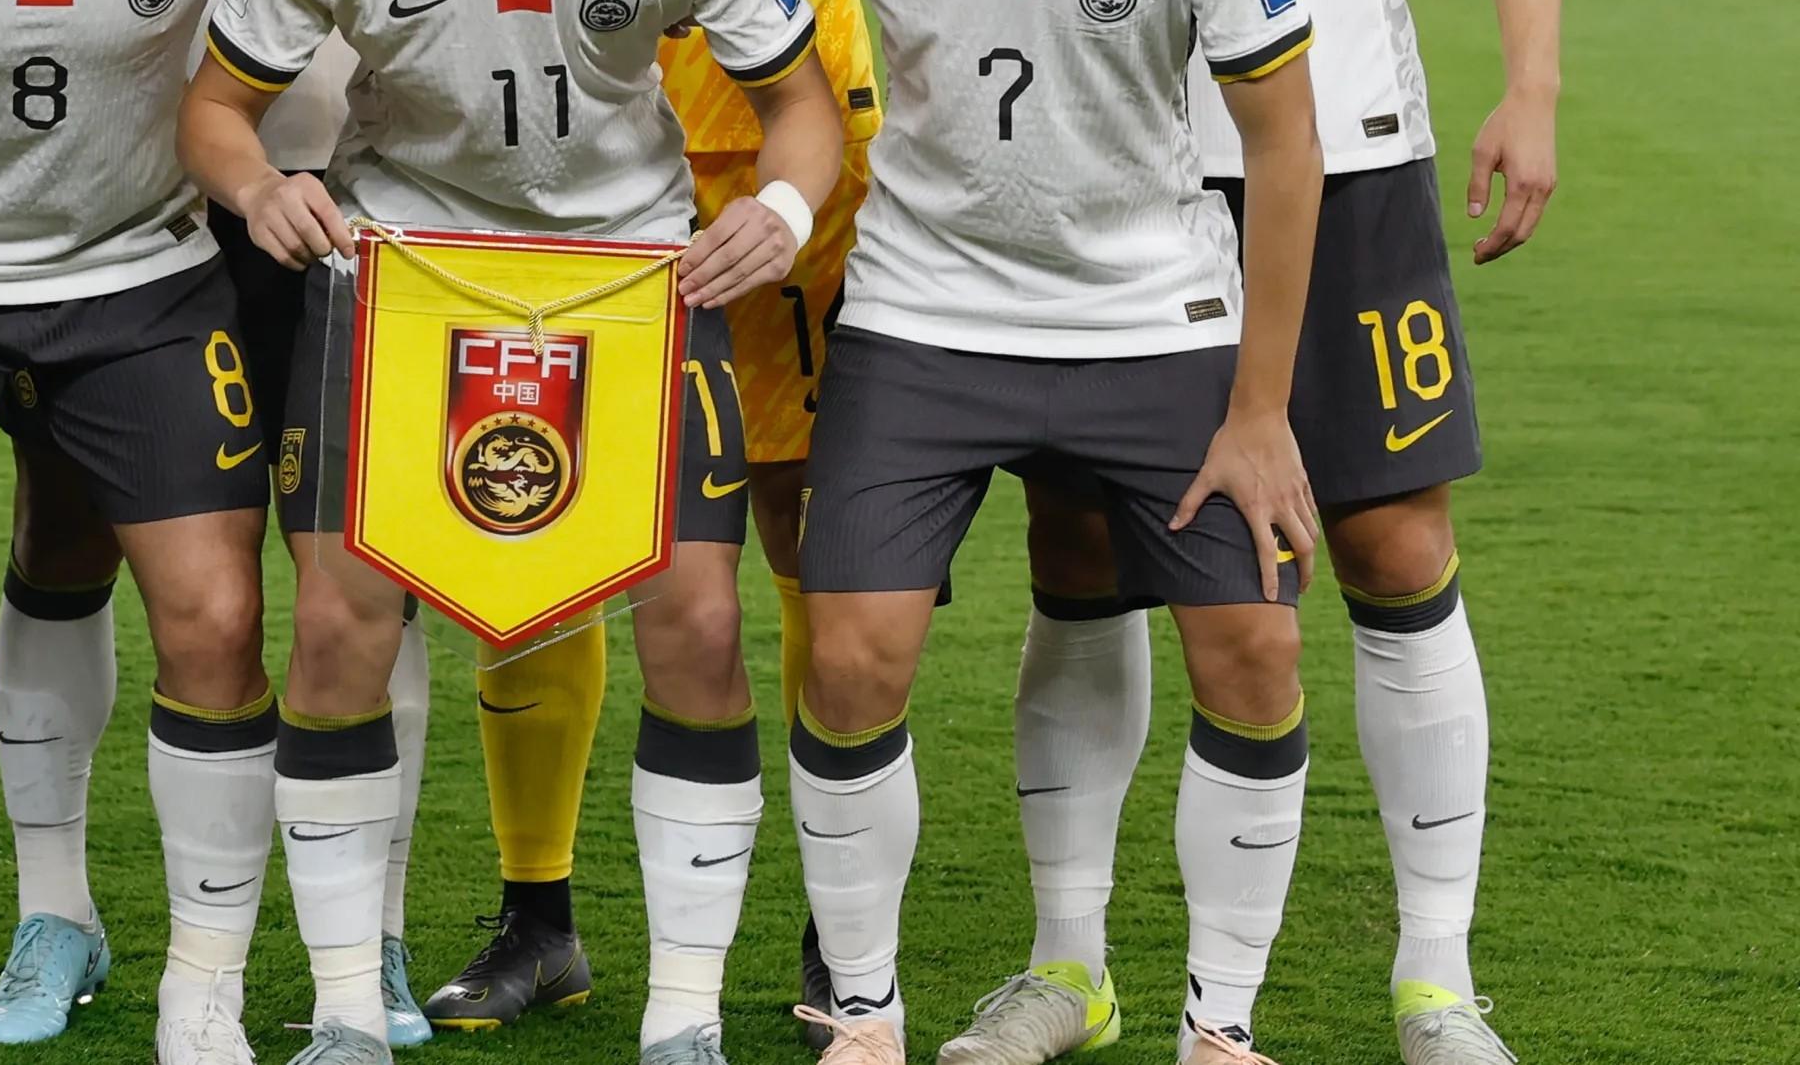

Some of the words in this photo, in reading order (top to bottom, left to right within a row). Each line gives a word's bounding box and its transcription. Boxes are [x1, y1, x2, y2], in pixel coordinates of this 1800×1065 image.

[12, 56, 68, 130] 8
[491, 64, 569, 147] 11
[979, 48, 1033, 141] 7
[204, 330, 253, 427] 8
[458, 337, 579, 380] CFA
[493, 379, 540, 406] 中国
[1357, 300, 1453, 409] 18
